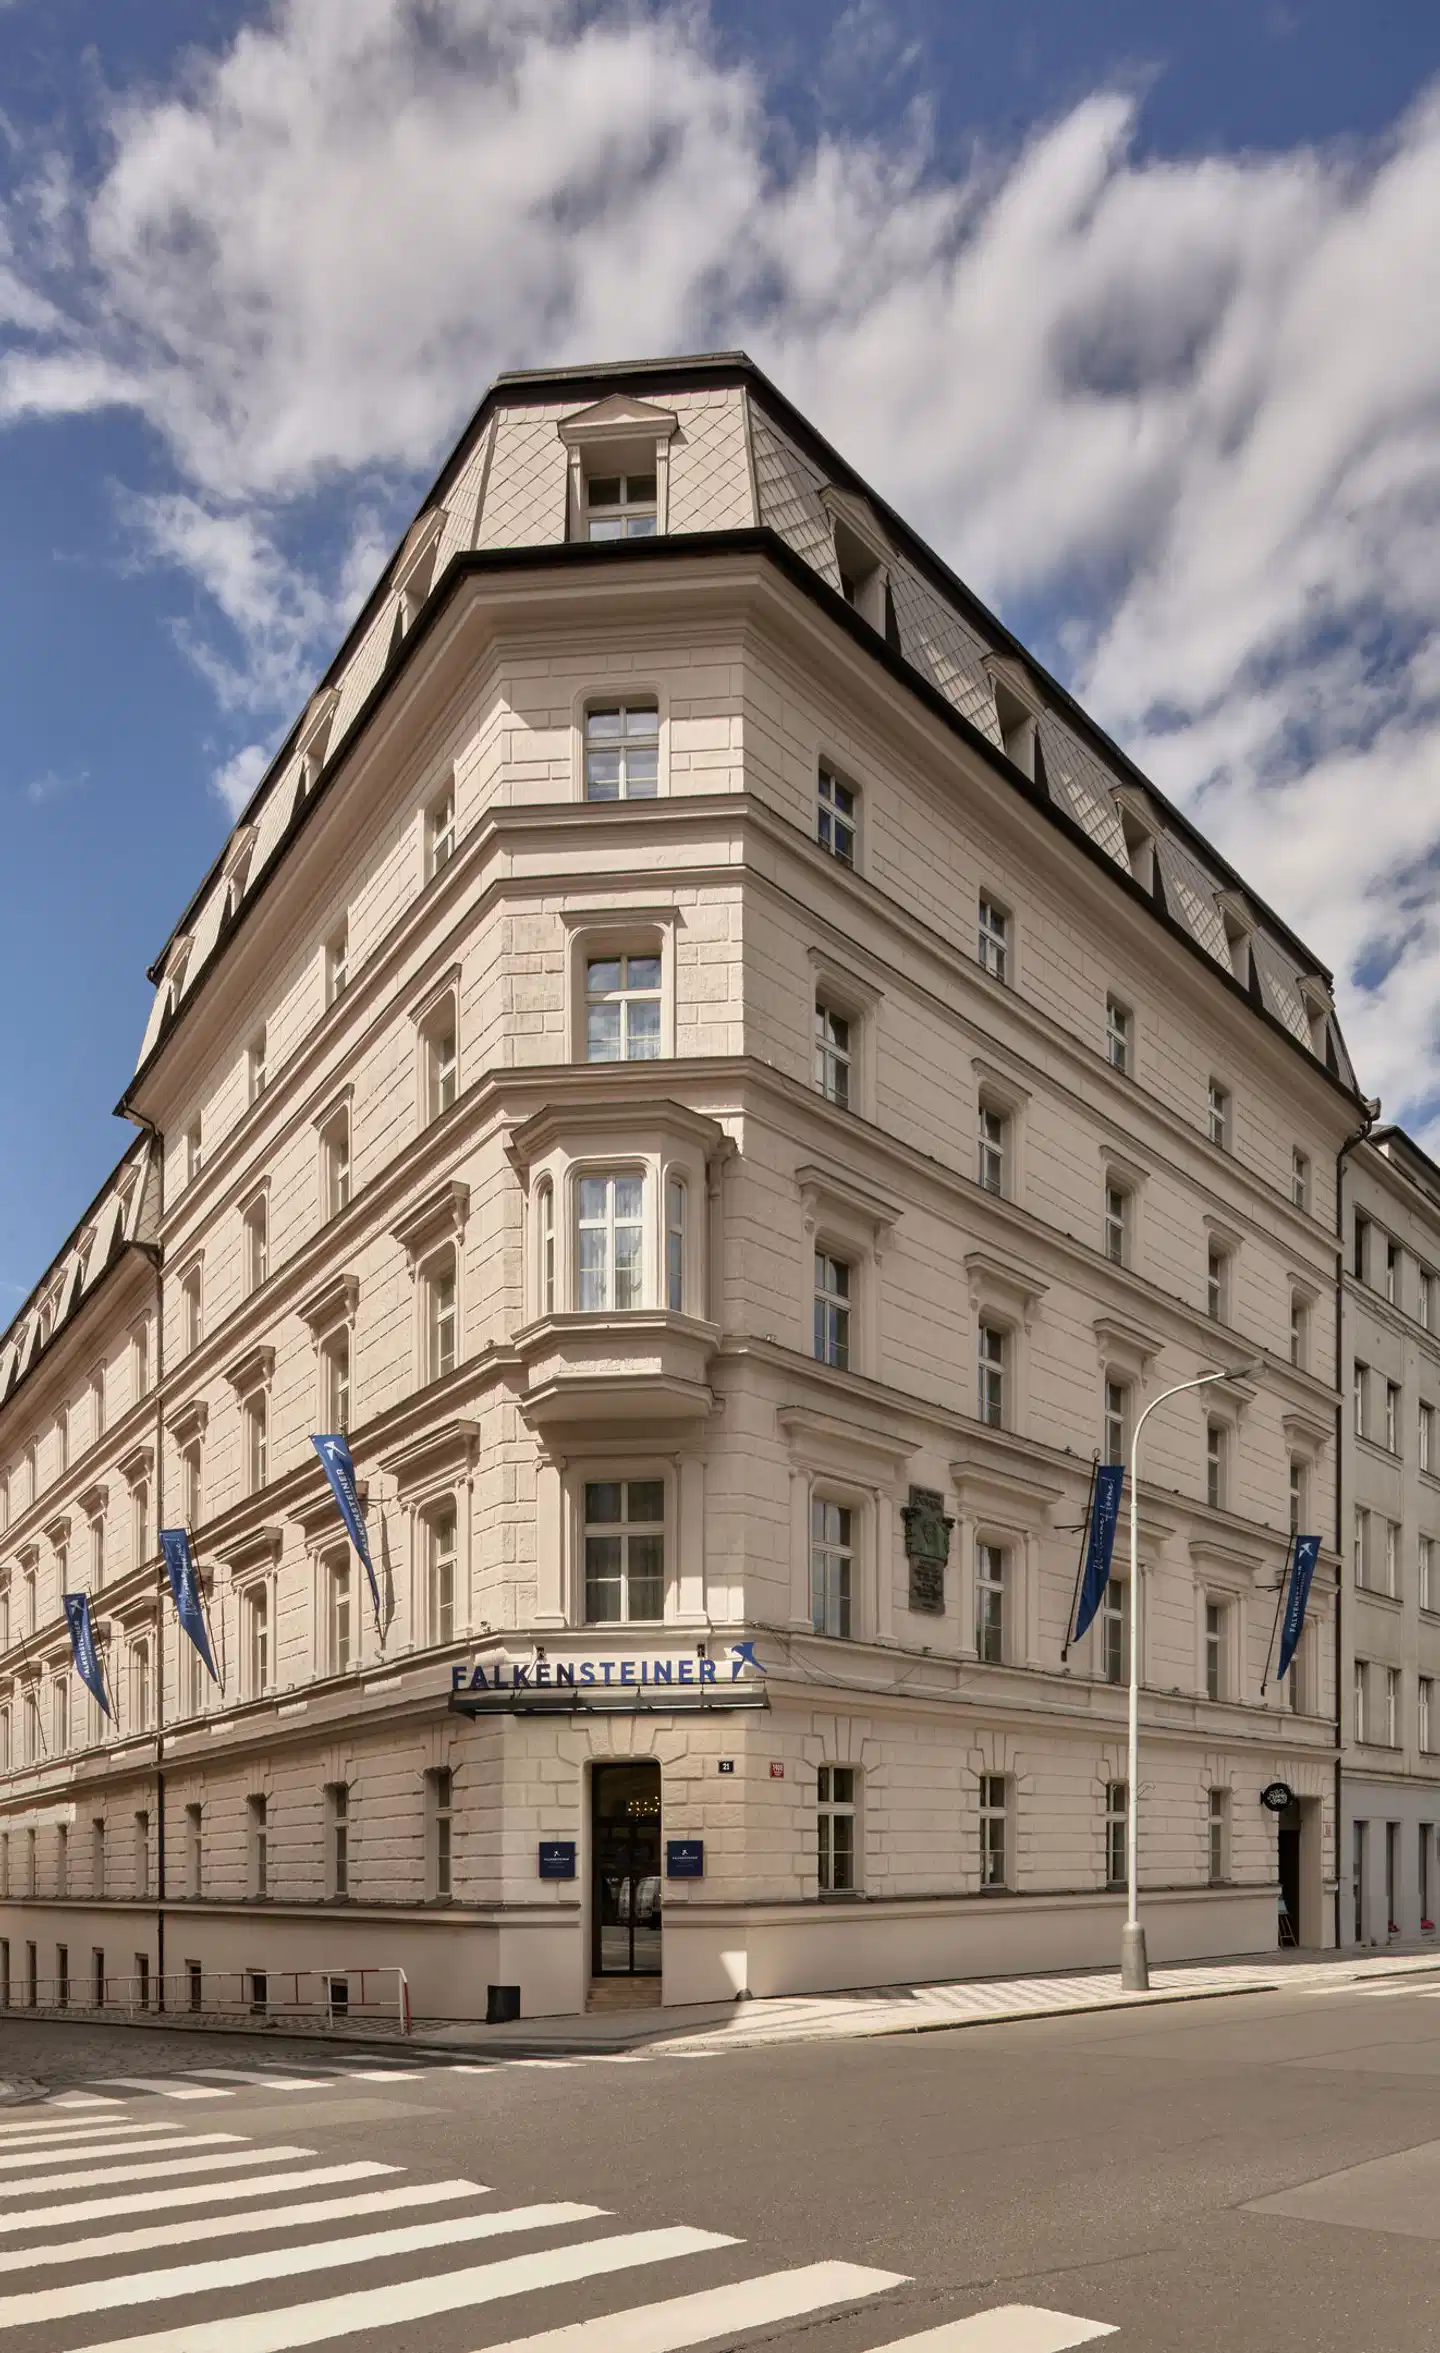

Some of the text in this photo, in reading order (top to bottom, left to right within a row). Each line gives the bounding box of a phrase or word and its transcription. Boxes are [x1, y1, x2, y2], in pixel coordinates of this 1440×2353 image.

[335, 1468, 369, 1557] FALKENSTEINER
[1289, 1565, 1303, 1633] FALKENSR
[452, 1659, 717, 1689] FALKENSTEINER
[722, 1762, 730, 1771] 21
